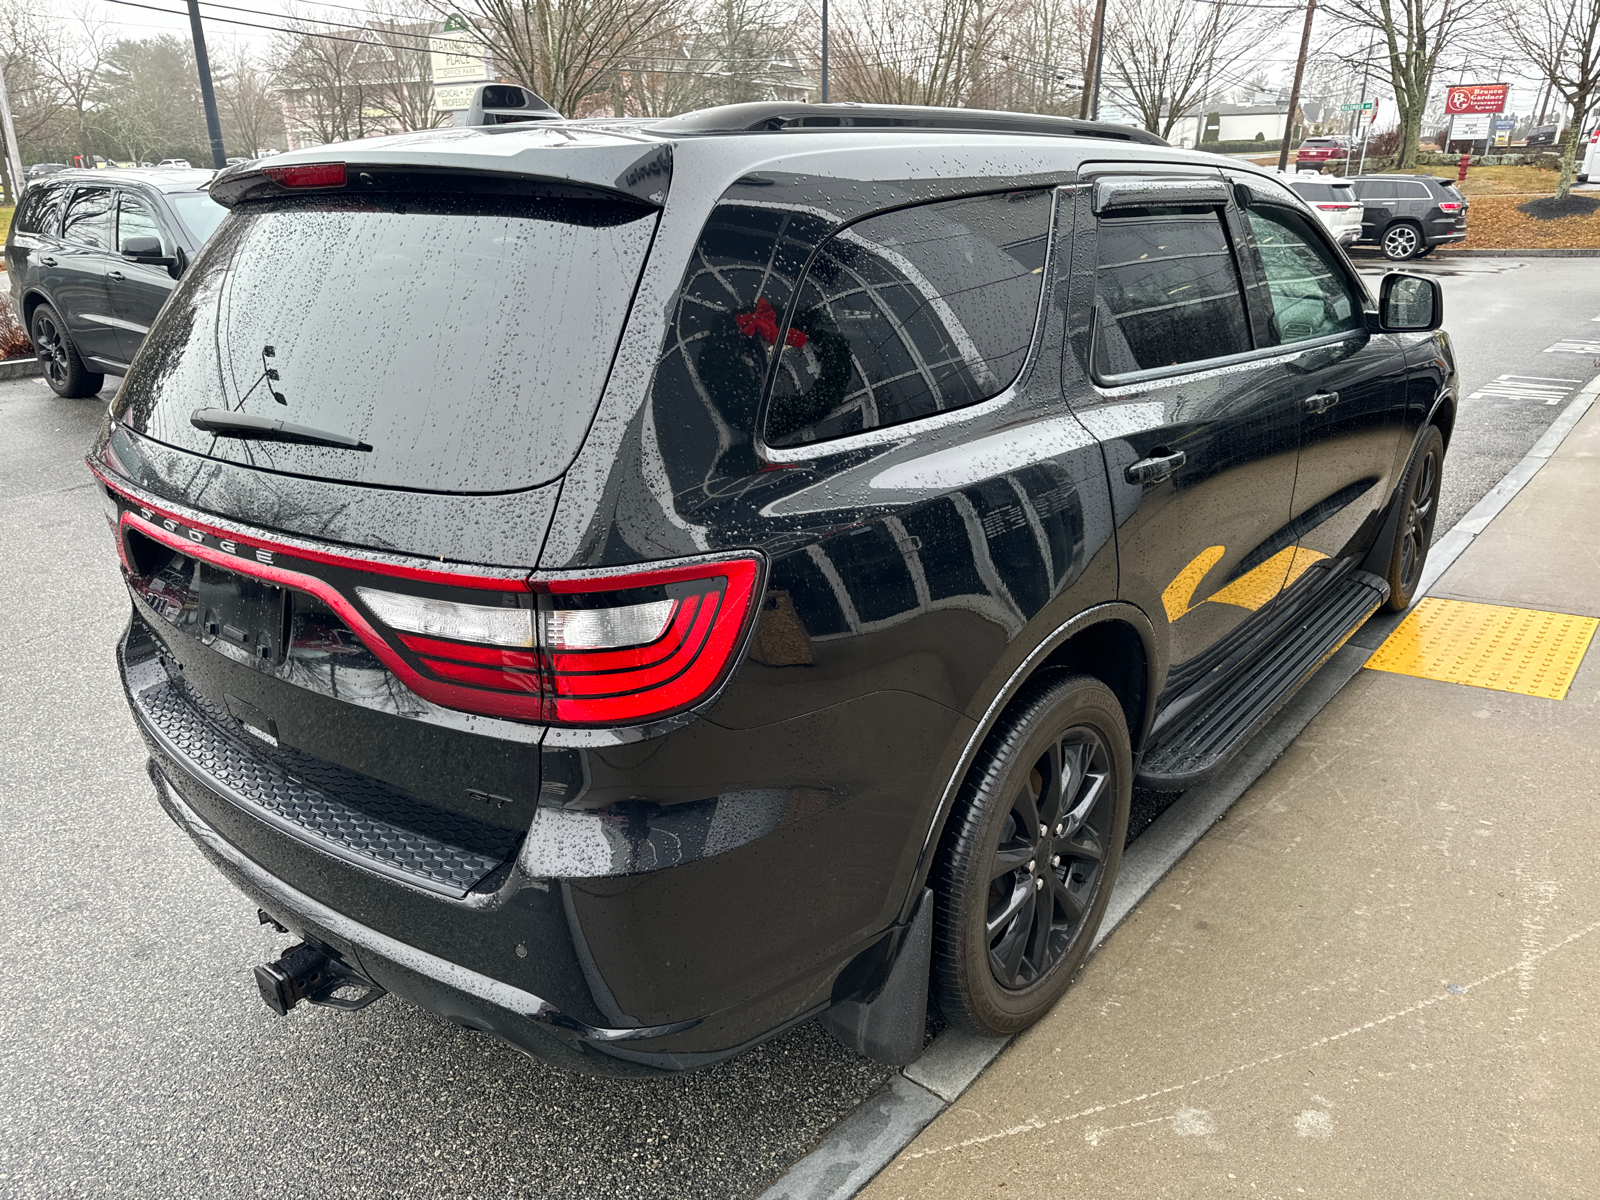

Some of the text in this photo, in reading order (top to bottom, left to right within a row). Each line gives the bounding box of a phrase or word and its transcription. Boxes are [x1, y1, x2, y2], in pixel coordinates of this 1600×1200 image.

[446, 53, 470, 66] PLACE
[443, 67, 476, 77] OFFICE PARK
[437, 89, 460, 98] MEDICAL
[442, 97, 471, 107] PROFESSIO
[140, 507, 275, 564] DODGE
